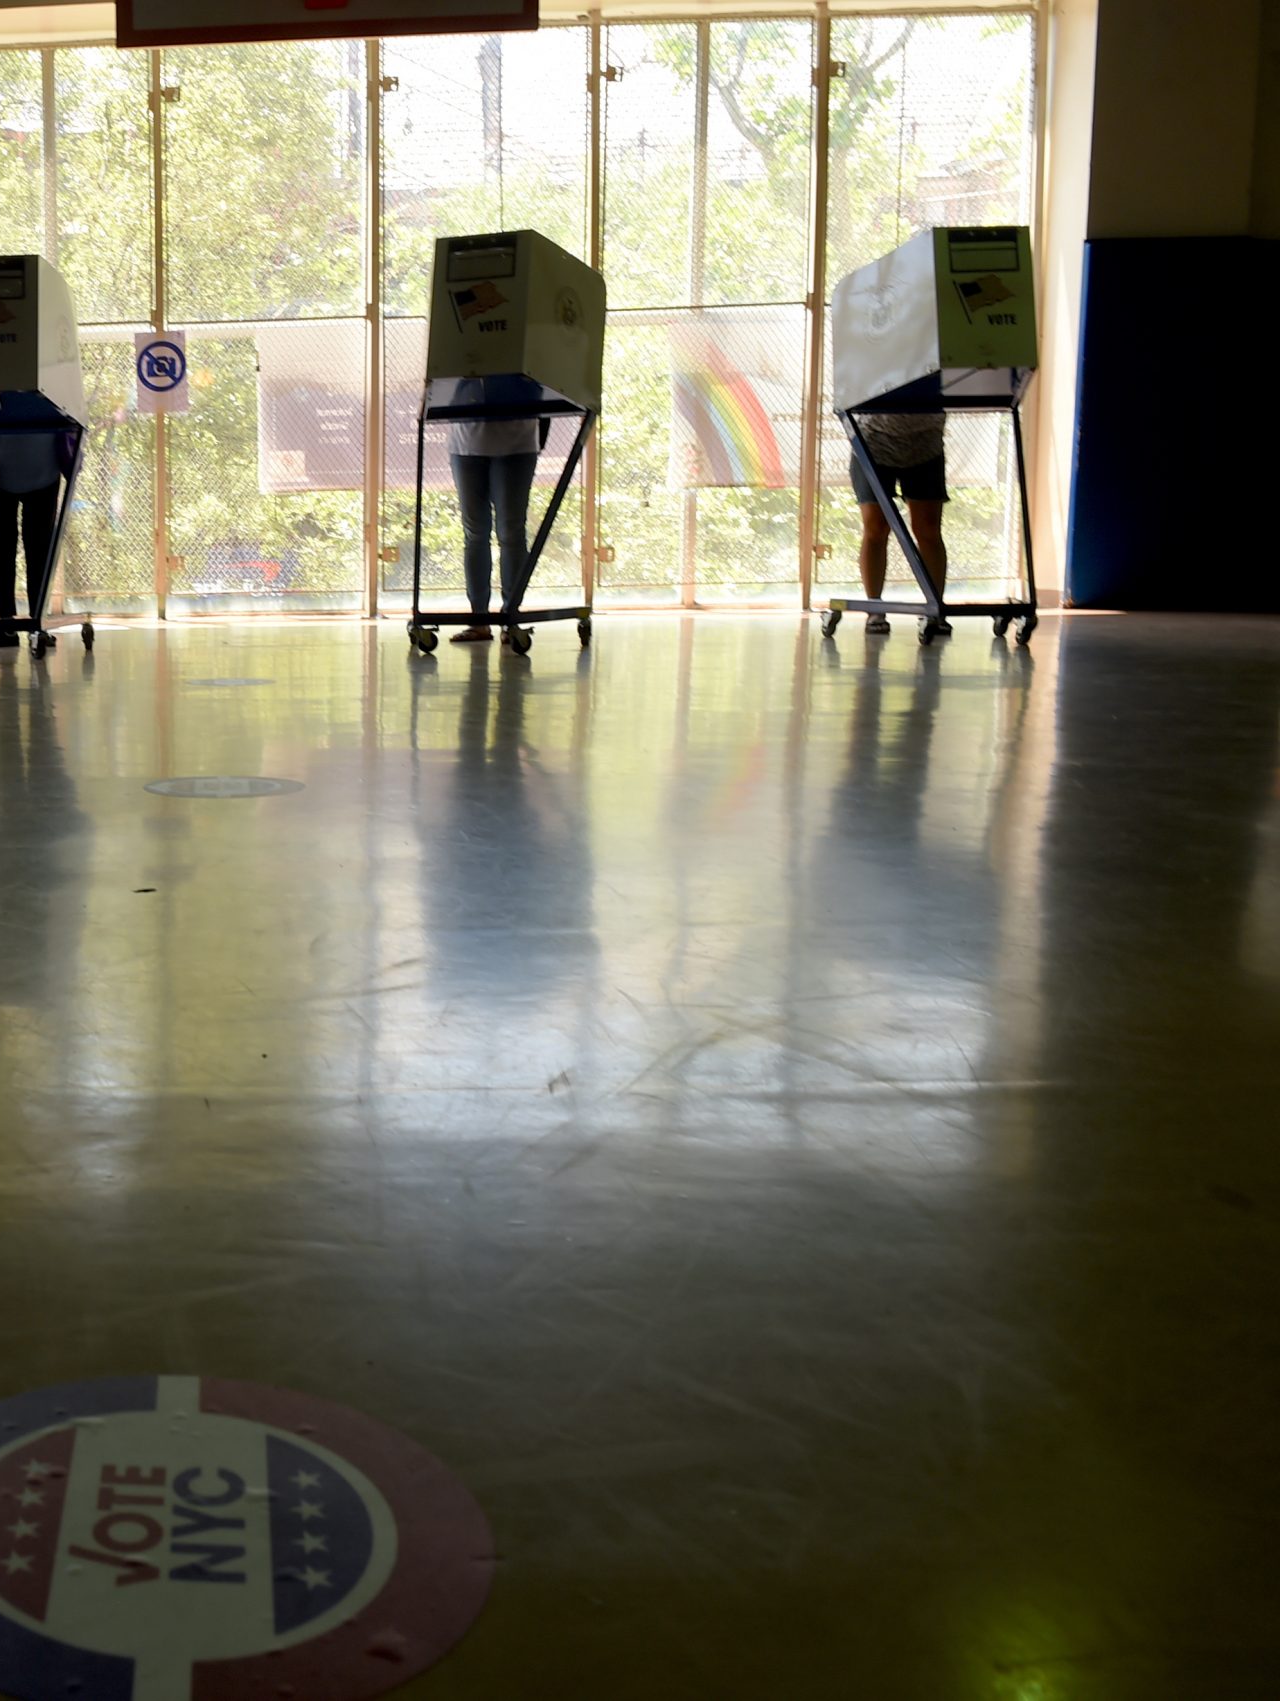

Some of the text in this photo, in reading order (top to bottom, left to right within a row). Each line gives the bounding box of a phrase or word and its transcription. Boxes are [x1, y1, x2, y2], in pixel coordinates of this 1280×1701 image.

[478, 320, 507, 332] VOTE
[987, 313, 1017, 325] VOTE
[69, 1465, 166, 1587] VOTE
[169, 1467, 246, 1583] NYC
